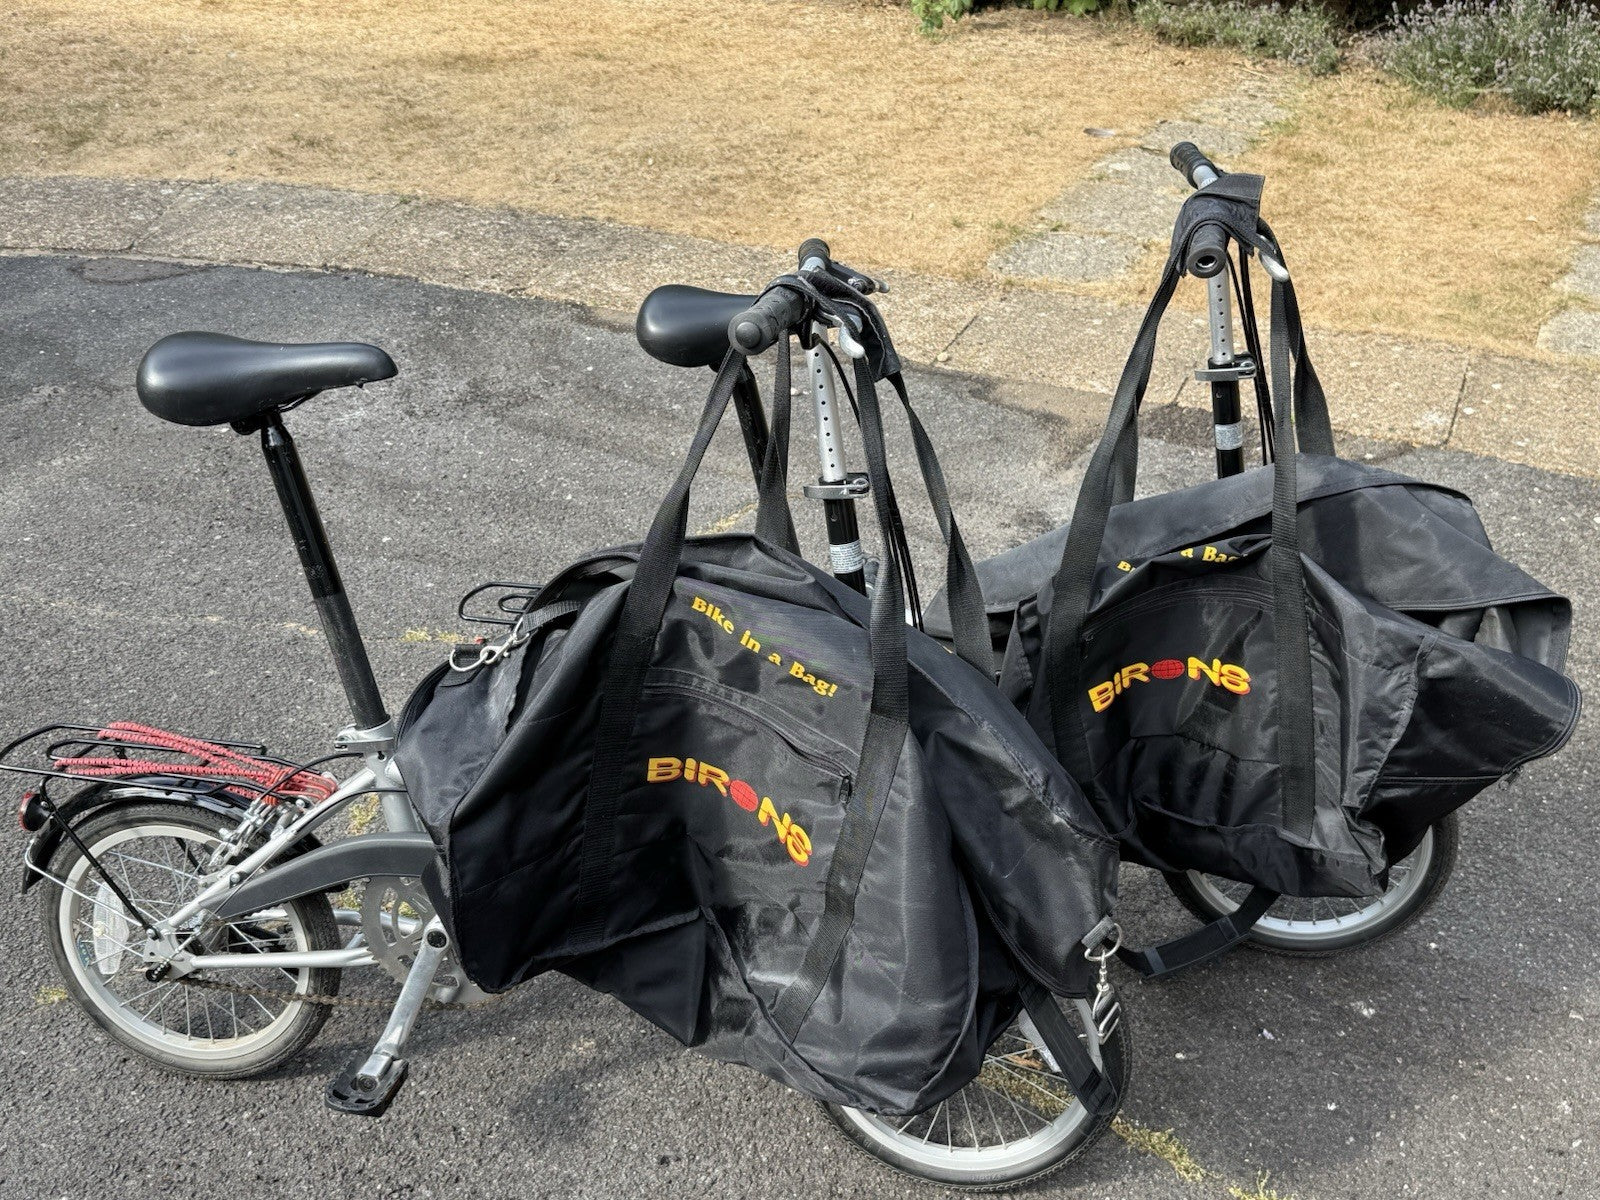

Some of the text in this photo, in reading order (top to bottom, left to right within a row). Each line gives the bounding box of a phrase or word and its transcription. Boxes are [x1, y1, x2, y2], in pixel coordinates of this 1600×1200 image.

[691, 596, 838, 698] Bike in a Bag!
[1087, 656, 1252, 713] BIRONS
[647, 756, 813, 867] BIRONS
